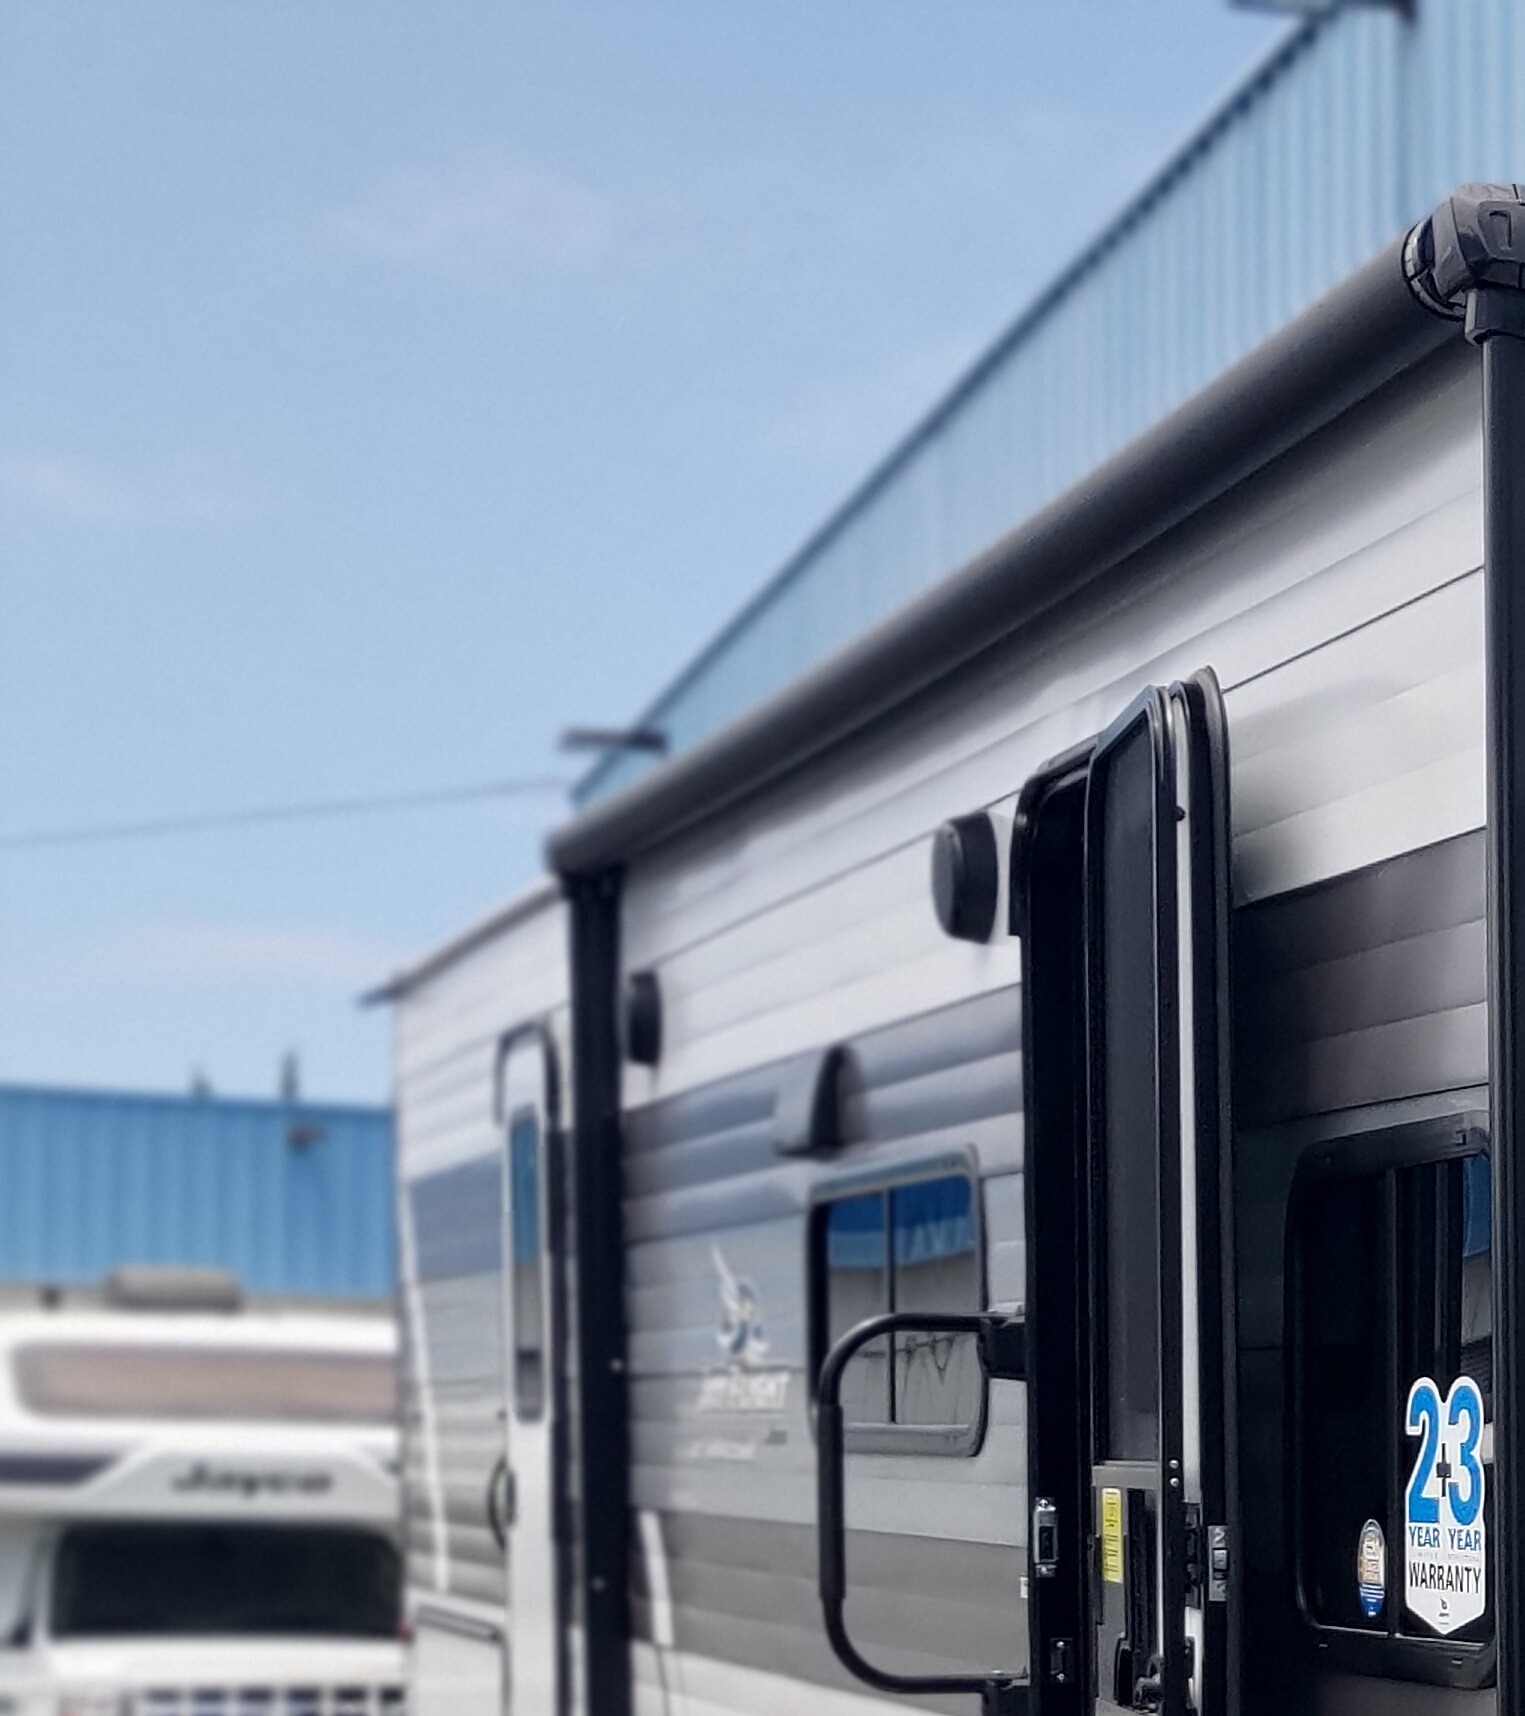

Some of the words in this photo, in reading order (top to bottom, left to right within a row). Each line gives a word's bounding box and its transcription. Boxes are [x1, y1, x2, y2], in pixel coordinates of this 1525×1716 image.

[1409, 1526, 1440, 1548] YEAR
[1448, 1528, 1481, 1551] YEAR
[1409, 1561, 1481, 1594] WARRANTY
